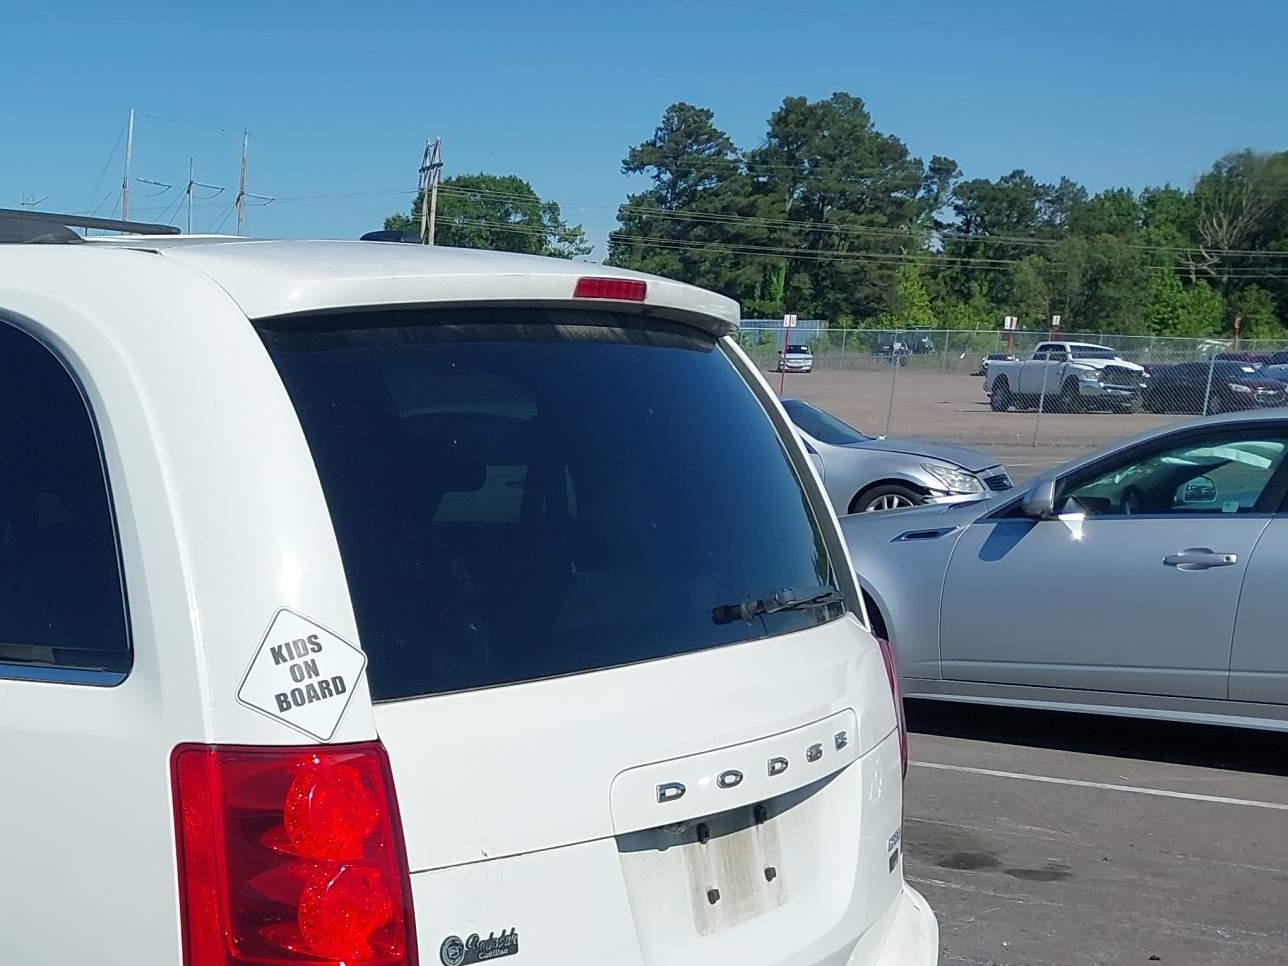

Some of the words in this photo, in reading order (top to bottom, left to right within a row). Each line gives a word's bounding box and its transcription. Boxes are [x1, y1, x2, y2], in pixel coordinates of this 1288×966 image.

[270, 634, 323, 666] KIDS
[289, 658, 321, 683] ON
[274, 675, 347, 713] BOARD
[656, 731, 849, 804] DODGE
